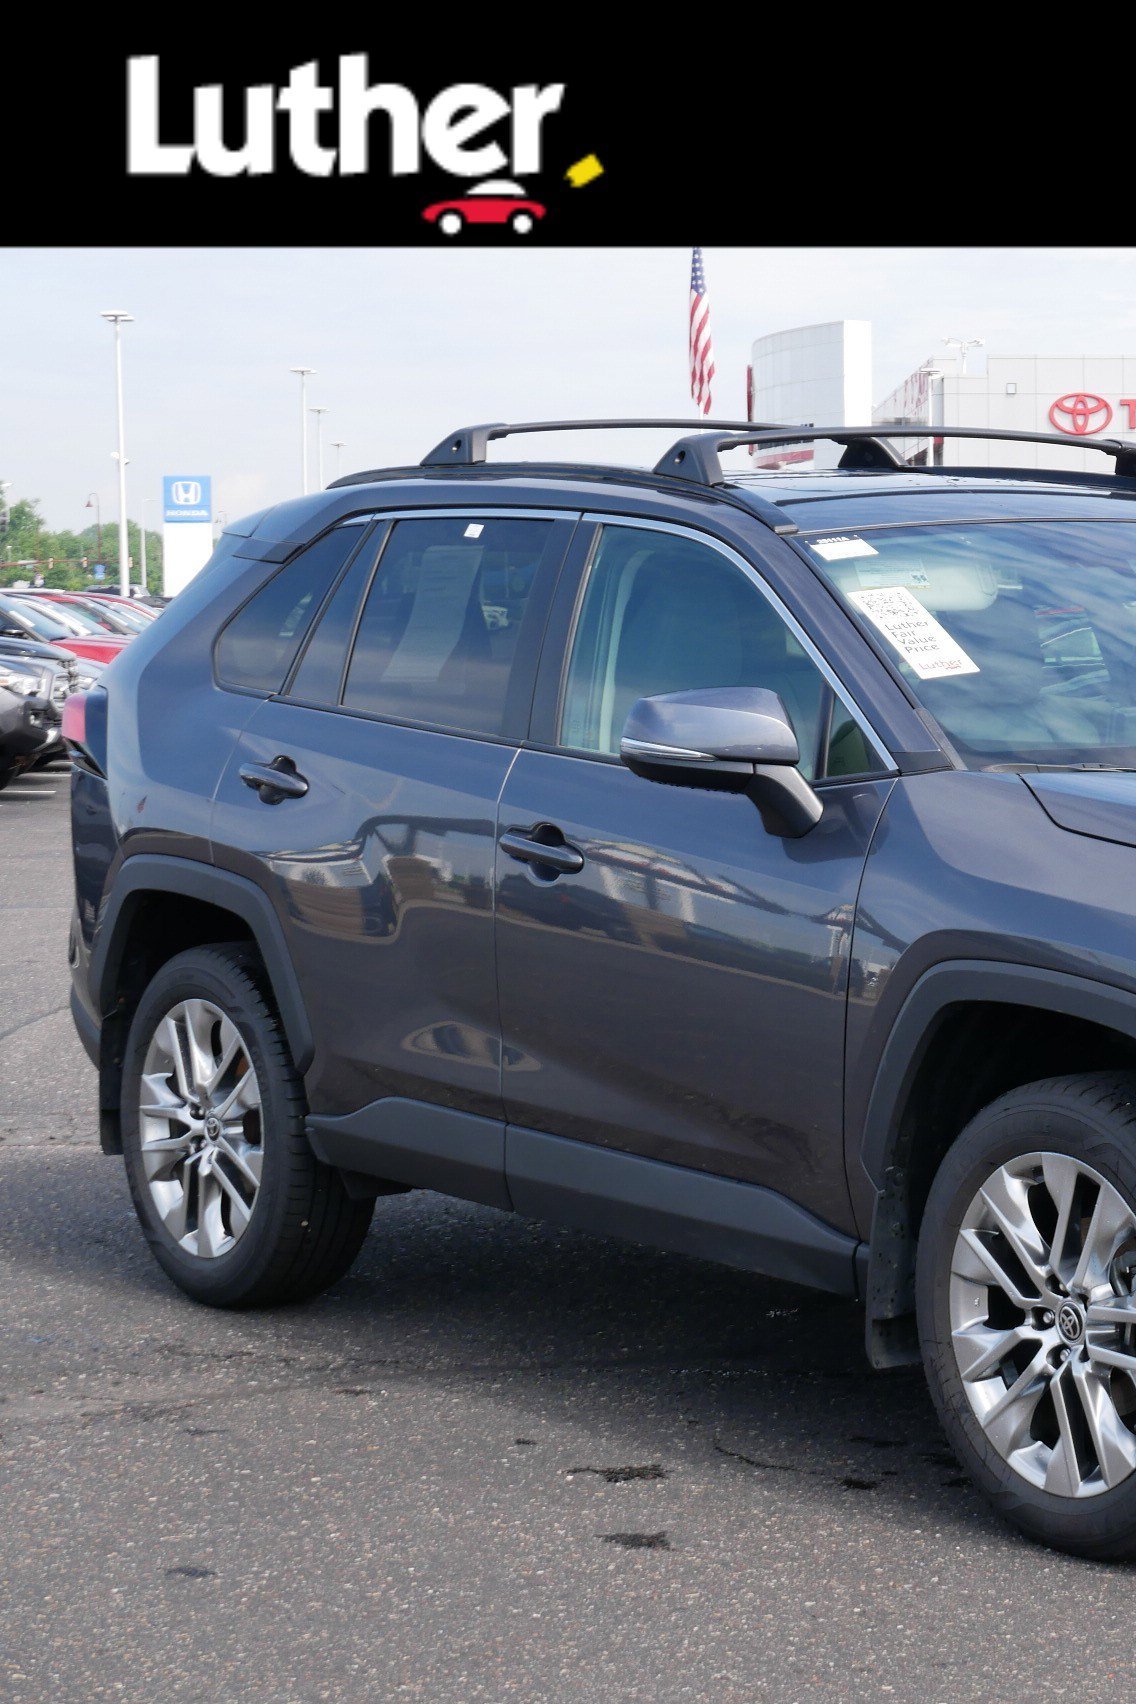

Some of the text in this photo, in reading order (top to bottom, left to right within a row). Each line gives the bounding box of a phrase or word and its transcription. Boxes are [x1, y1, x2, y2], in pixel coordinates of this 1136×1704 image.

[885, 621, 929, 631] Luther
[891, 630, 916, 639] Fair
[904, 644, 940, 654] Price
